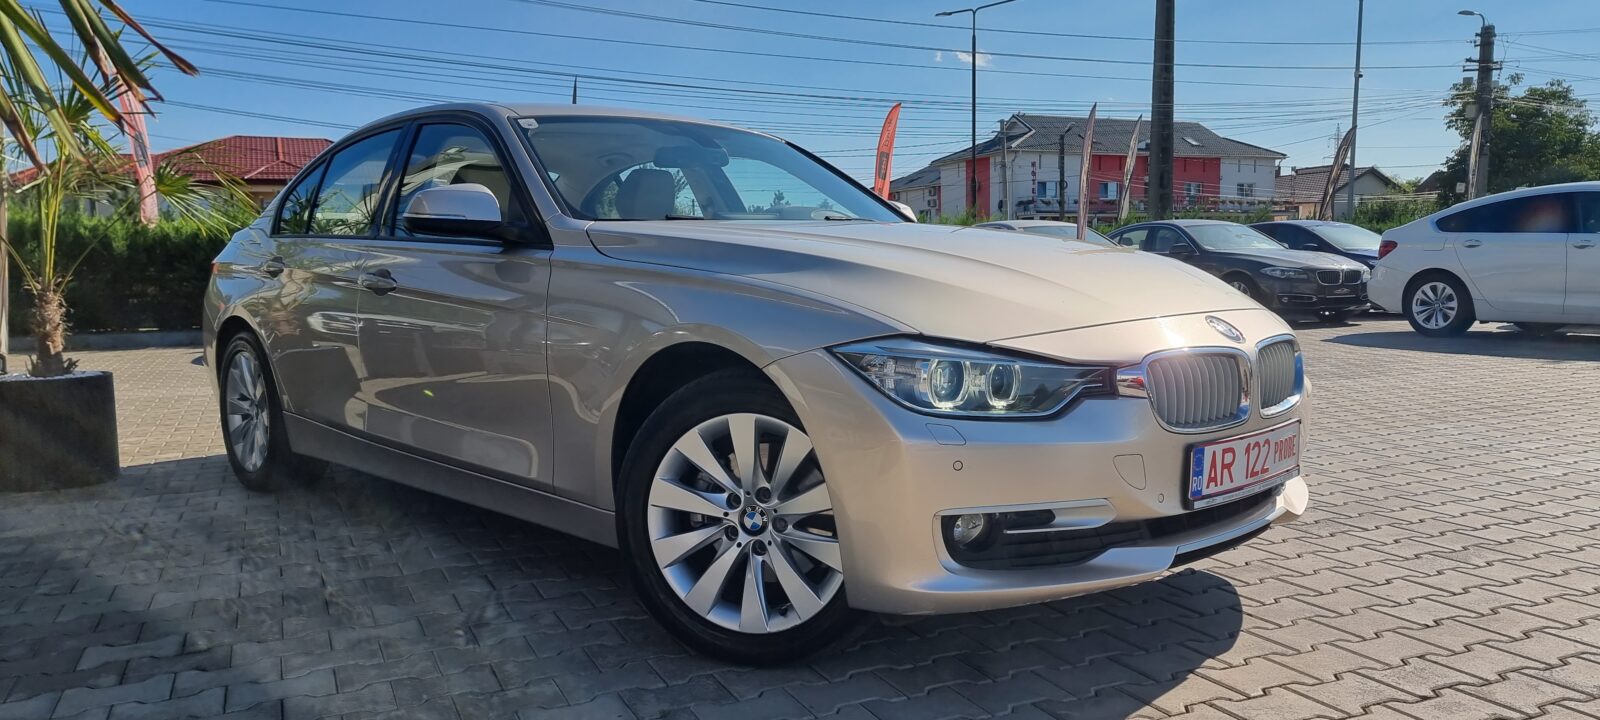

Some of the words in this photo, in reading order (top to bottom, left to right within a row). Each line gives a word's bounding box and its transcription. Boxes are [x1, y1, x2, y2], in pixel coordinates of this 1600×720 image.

[1206, 447, 1236, 489] AR
[1244, 438, 1271, 480] 122
[1273, 435, 1297, 464] PROBE
[1191, 476, 1203, 492] RO
